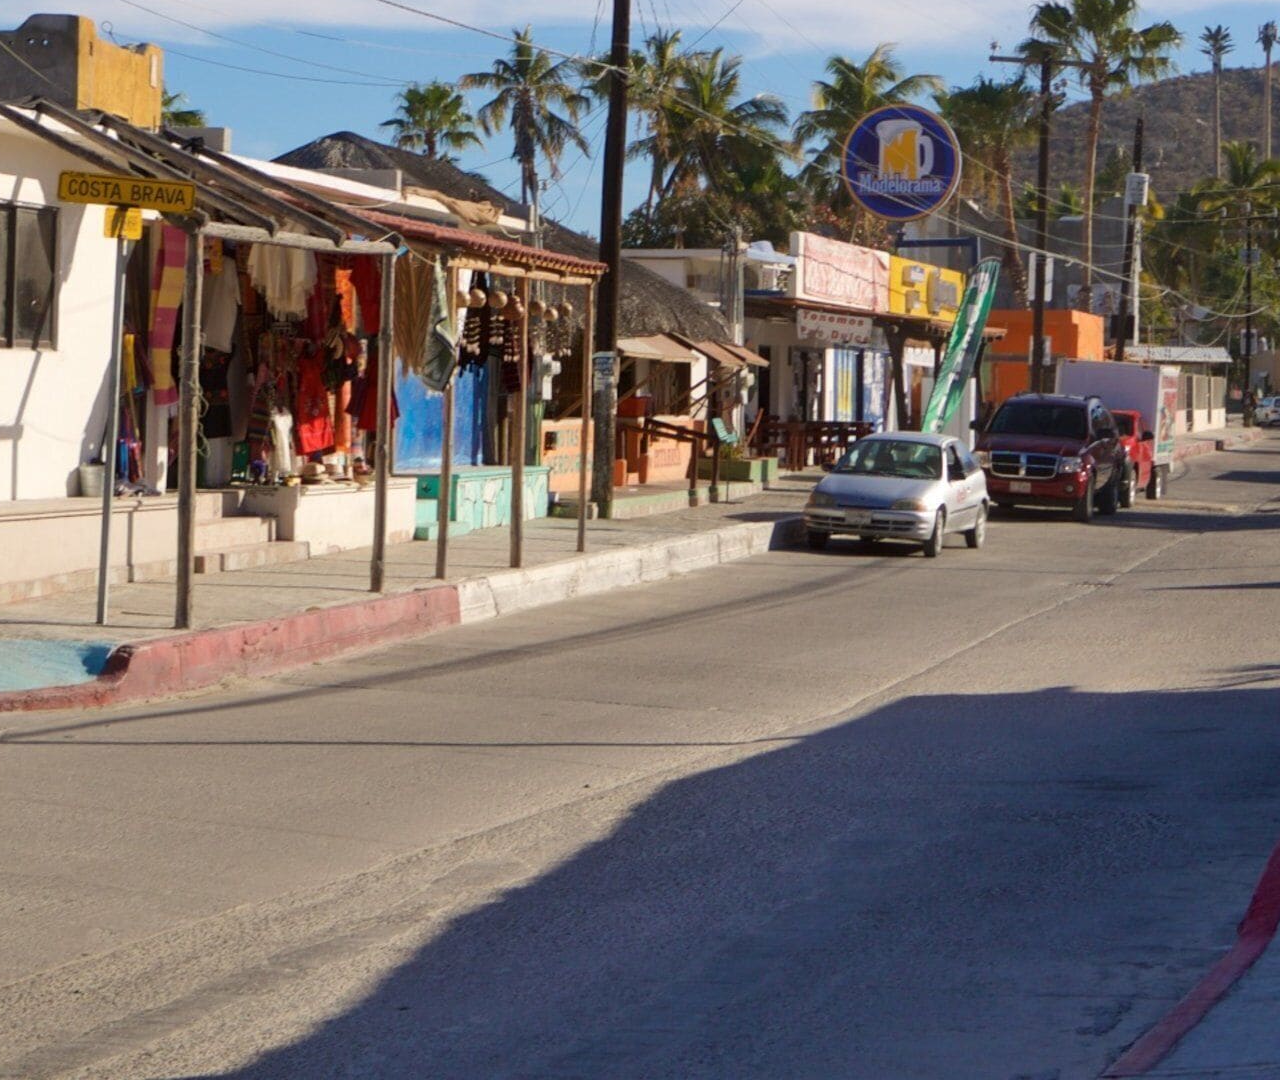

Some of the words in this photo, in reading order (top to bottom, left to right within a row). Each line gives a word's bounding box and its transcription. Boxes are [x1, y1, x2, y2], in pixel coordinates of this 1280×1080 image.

[68, 178, 122, 200] COSTA
[130, 184, 186, 206] BRAVA
[860, 173, 941, 193] Modelorama
